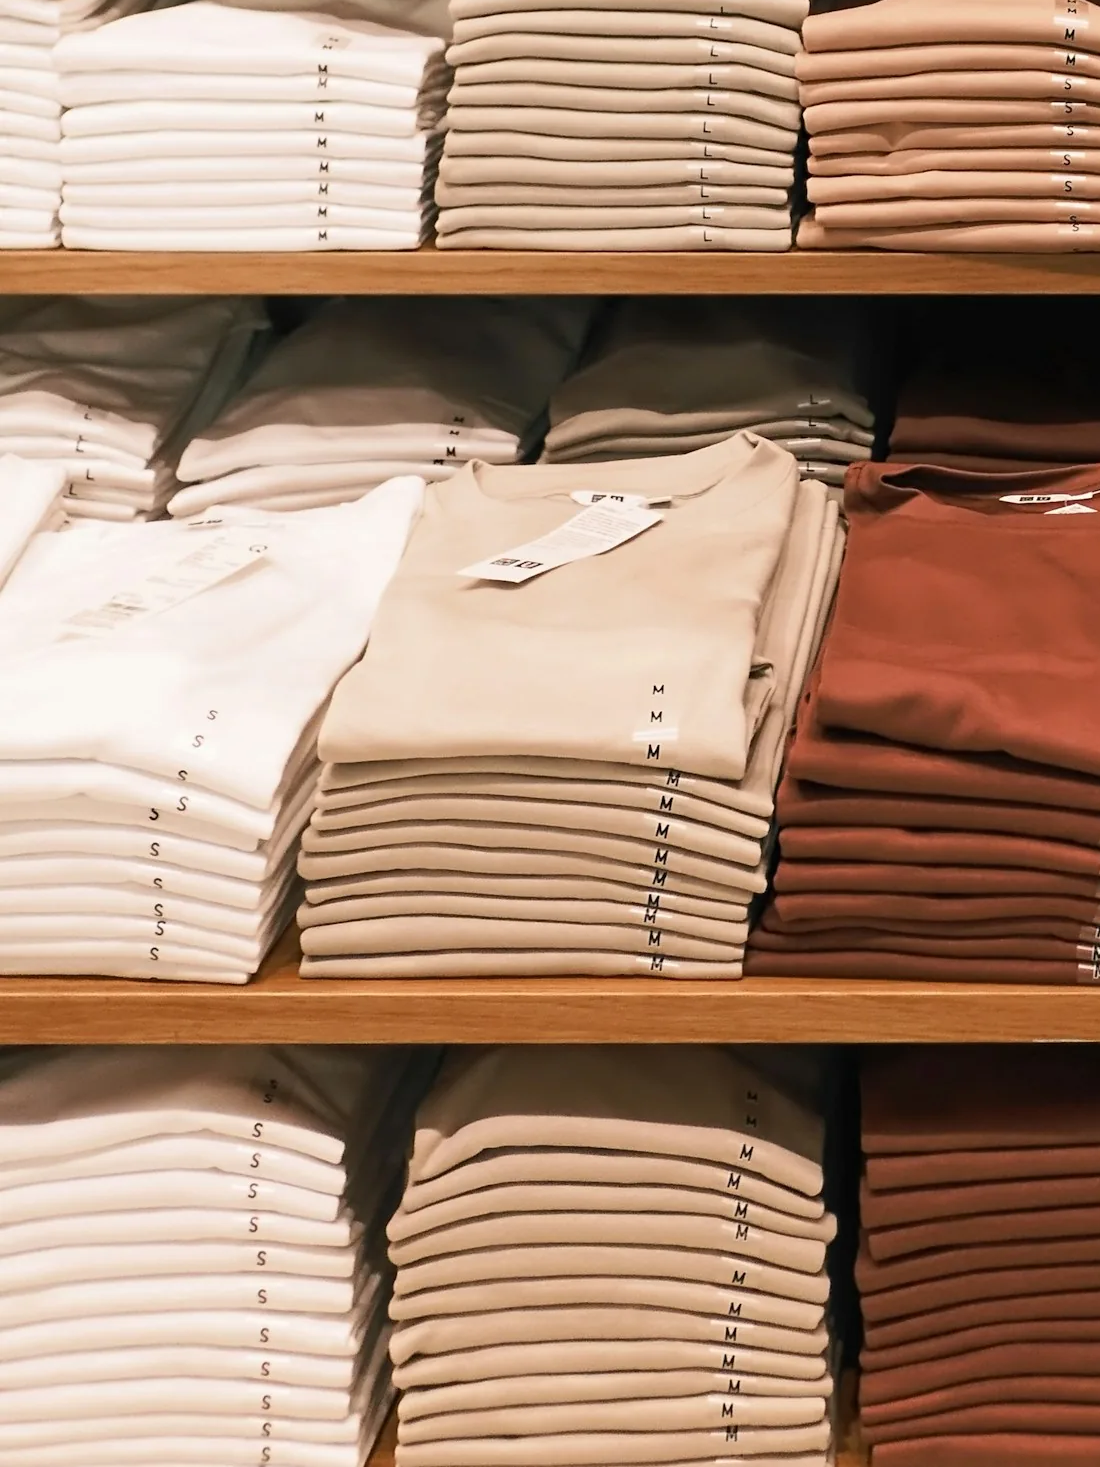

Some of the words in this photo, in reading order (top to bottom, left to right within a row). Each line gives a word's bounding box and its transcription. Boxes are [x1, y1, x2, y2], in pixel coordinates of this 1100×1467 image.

[1064, 28, 1075, 41] M
[1066, 54, 1076, 66] M
[709, 73, 718, 85] L
[315, 112, 324, 123] M
[704, 121, 711, 133] L
[319, 161, 329, 172] M
[1063, 154, 1071, 166] S
[1065, 180, 1073, 192] S
[318, 206, 328, 217] M
[319, 230, 329, 241] M
[704, 230, 712, 241] L
[446, 446, 456, 457] M
[86, 468, 95, 481] L
[69, 483, 78, 495] L
[652, 685, 664, 695] M
[207, 709, 218, 721] S
[650, 711, 663, 723] M
[192, 734, 204, 748] S
[647, 744, 661, 759] M
[176, 795, 190, 812] S
[660, 795, 674, 811] M
[656, 823, 670, 839] M
[149, 842, 160, 857] S
[654, 848, 668, 864] M
[652, 870, 667, 886] M
[154, 902, 164, 917] S
[154, 920, 166, 936] S
[649, 930, 661, 945] M
[149, 947, 159, 961] S
[252, 1123, 263, 1138] S
[250, 1152, 261, 1168] S
[740, 1143, 753, 1162] M
[727, 1172, 741, 1190] M
[734, 1202, 748, 1218] M
[248, 1216, 259, 1233] S
[736, 1224, 749, 1240] M
[256, 1251, 267, 1266] S
[732, 1270, 746, 1285] M
[258, 1289, 267, 1304] S
[728, 1302, 742, 1316] M
[260, 1327, 269, 1343] S
[725, 1327, 737, 1341] M
[722, 1353, 735, 1368] M
[261, 1361, 270, 1376] S
[728, 1379, 740, 1394] M
[261, 1395, 271, 1410] S
[722, 1402, 733, 1417] M
